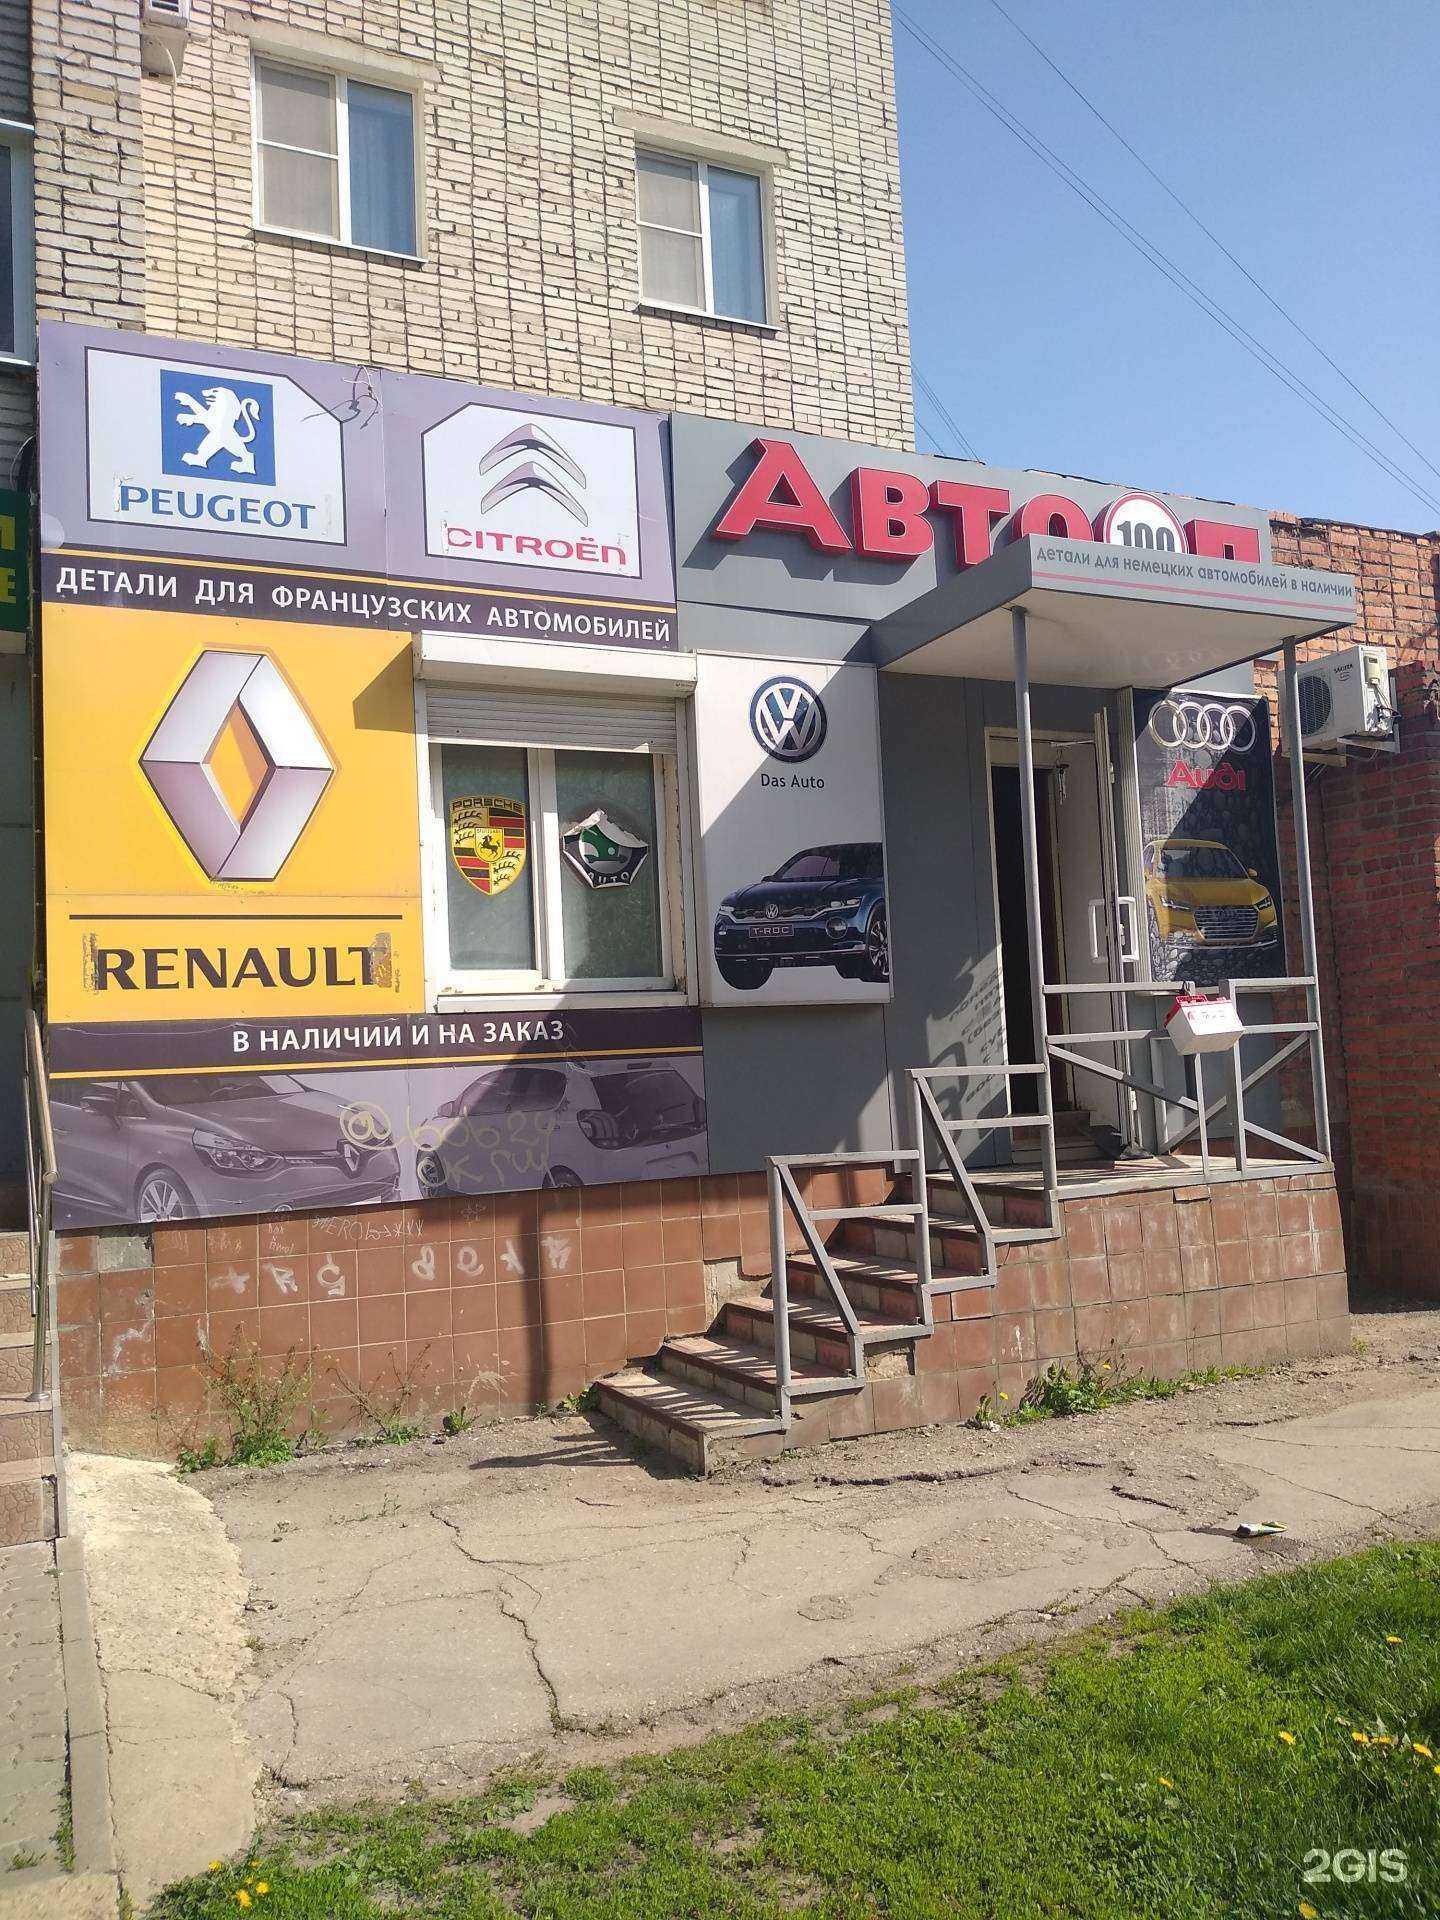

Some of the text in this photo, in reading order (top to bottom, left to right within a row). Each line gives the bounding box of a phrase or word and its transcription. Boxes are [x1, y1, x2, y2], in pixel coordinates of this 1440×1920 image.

[119, 485, 316, 530] PEUGEOT
[1094, 554, 1119, 570] для
[1123, 557, 1194, 579] немецких
[1197, 566, 1288, 590] автомобилей
[1290, 579, 1298, 590] в
[1301, 580, 1353, 598] наличии
[56, 566, 670, 642] ДЕТАЛИ ДЛЯ ФРАНЦУЗСКИХ АВТОМОБИЛЕЙ
[760, 774, 825, 789] Das Auto
[1166, 758, 1247, 791] Audi
[752, 925, 790, 935] T-ROC
[94, 946, 386, 991] RENAULT
[233, 1020, 565, 1052] В НАЛИЧИИ И НА ЗАКАЗ
